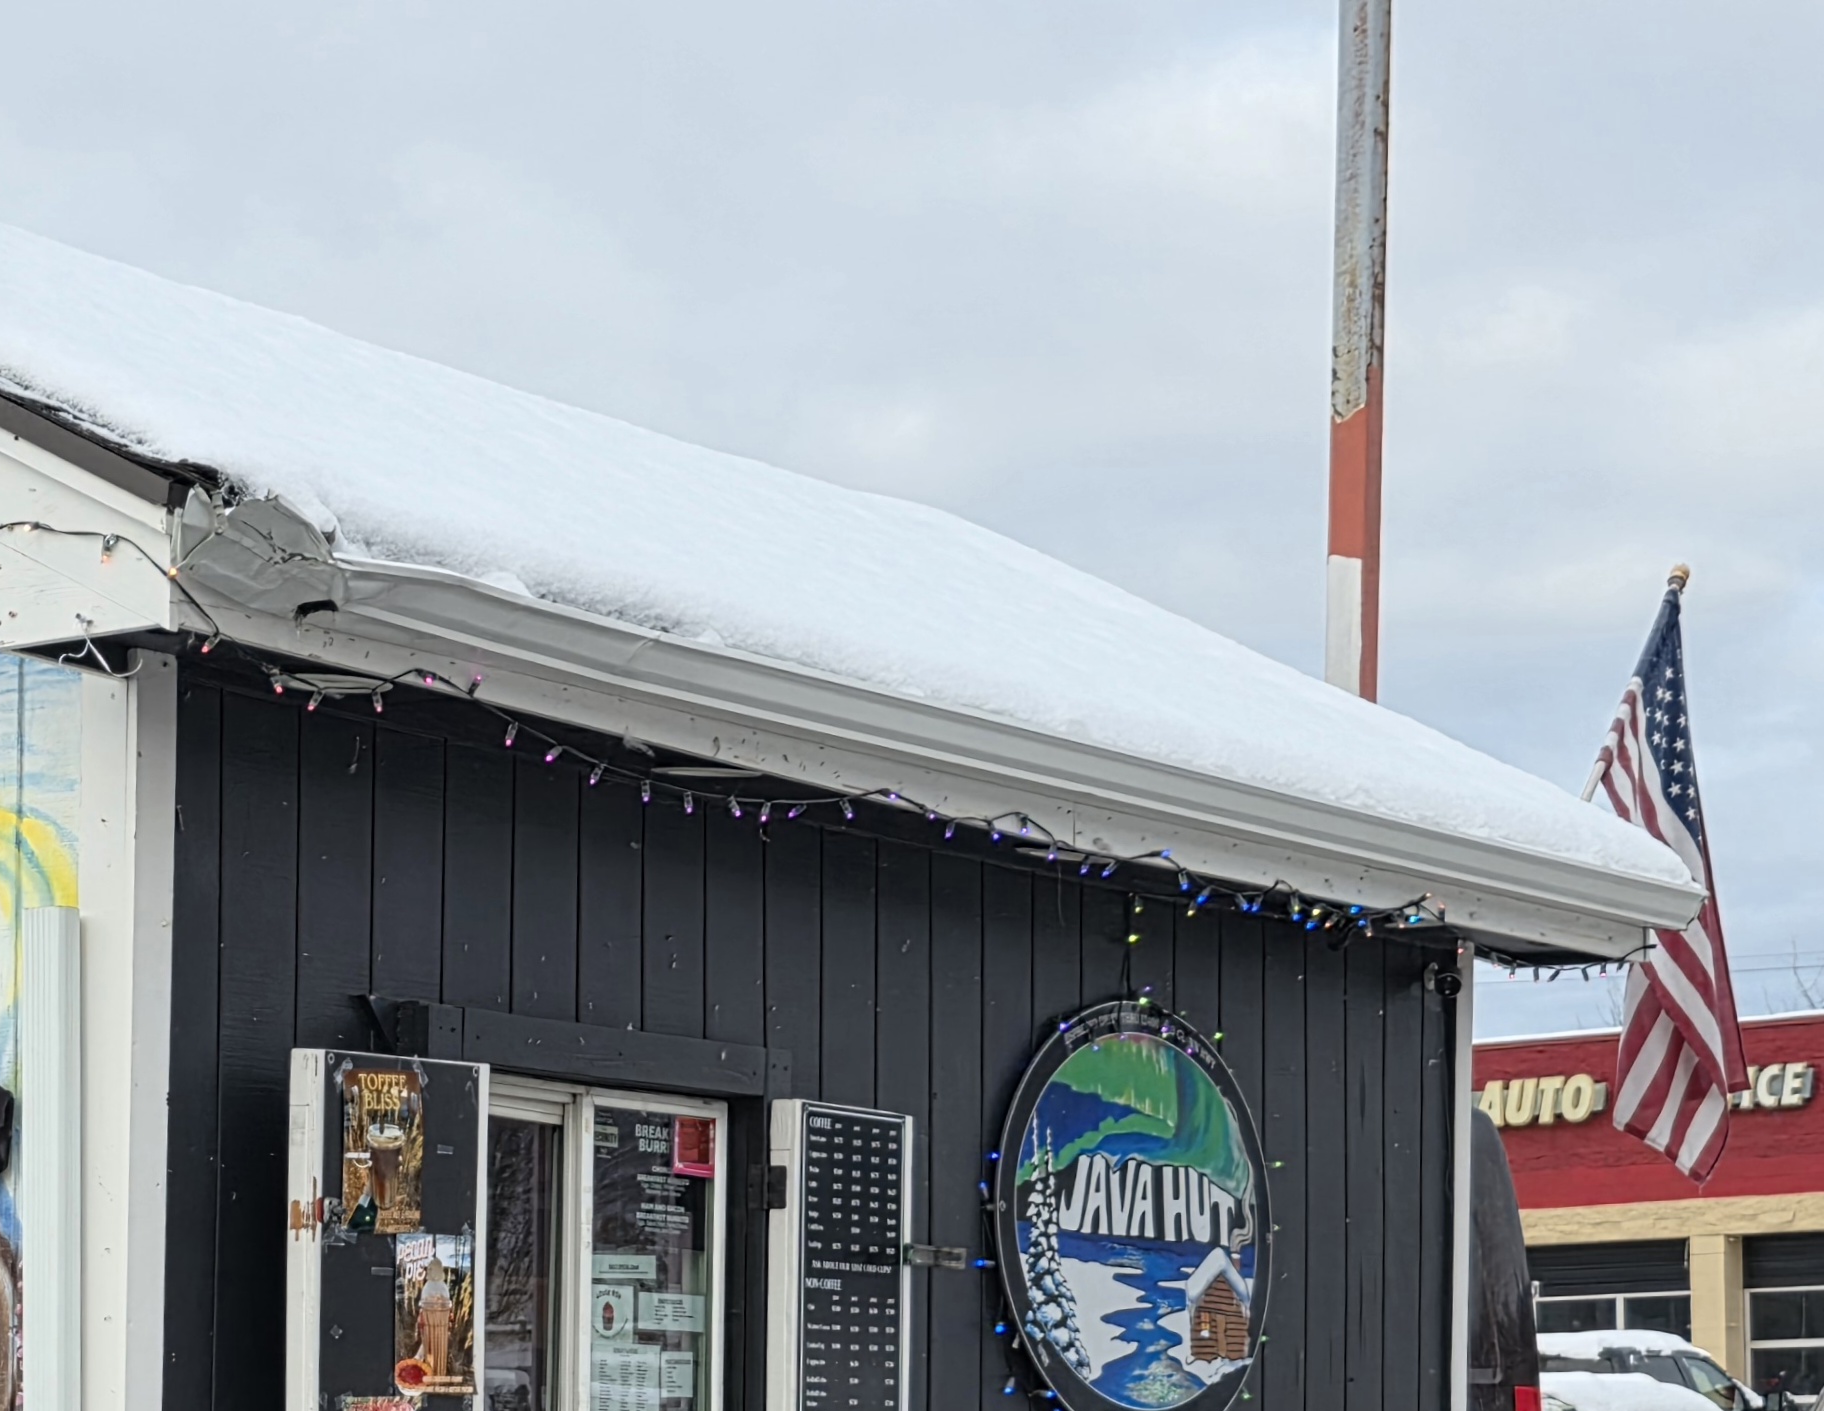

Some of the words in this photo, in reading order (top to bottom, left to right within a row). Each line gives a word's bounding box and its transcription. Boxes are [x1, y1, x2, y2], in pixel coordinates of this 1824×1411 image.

[358, 1074, 407, 1090] TOFFEE
[365, 1093, 400, 1109] BLISS
[1478, 1074, 1596, 1127] AUTO
[1728, 1062, 1808, 1110] ICE
[635, 1124, 672, 1140] BREAK
[1058, 1153, 1155, 1238] JAVA
[1162, 1165, 1236, 1247] HUT
